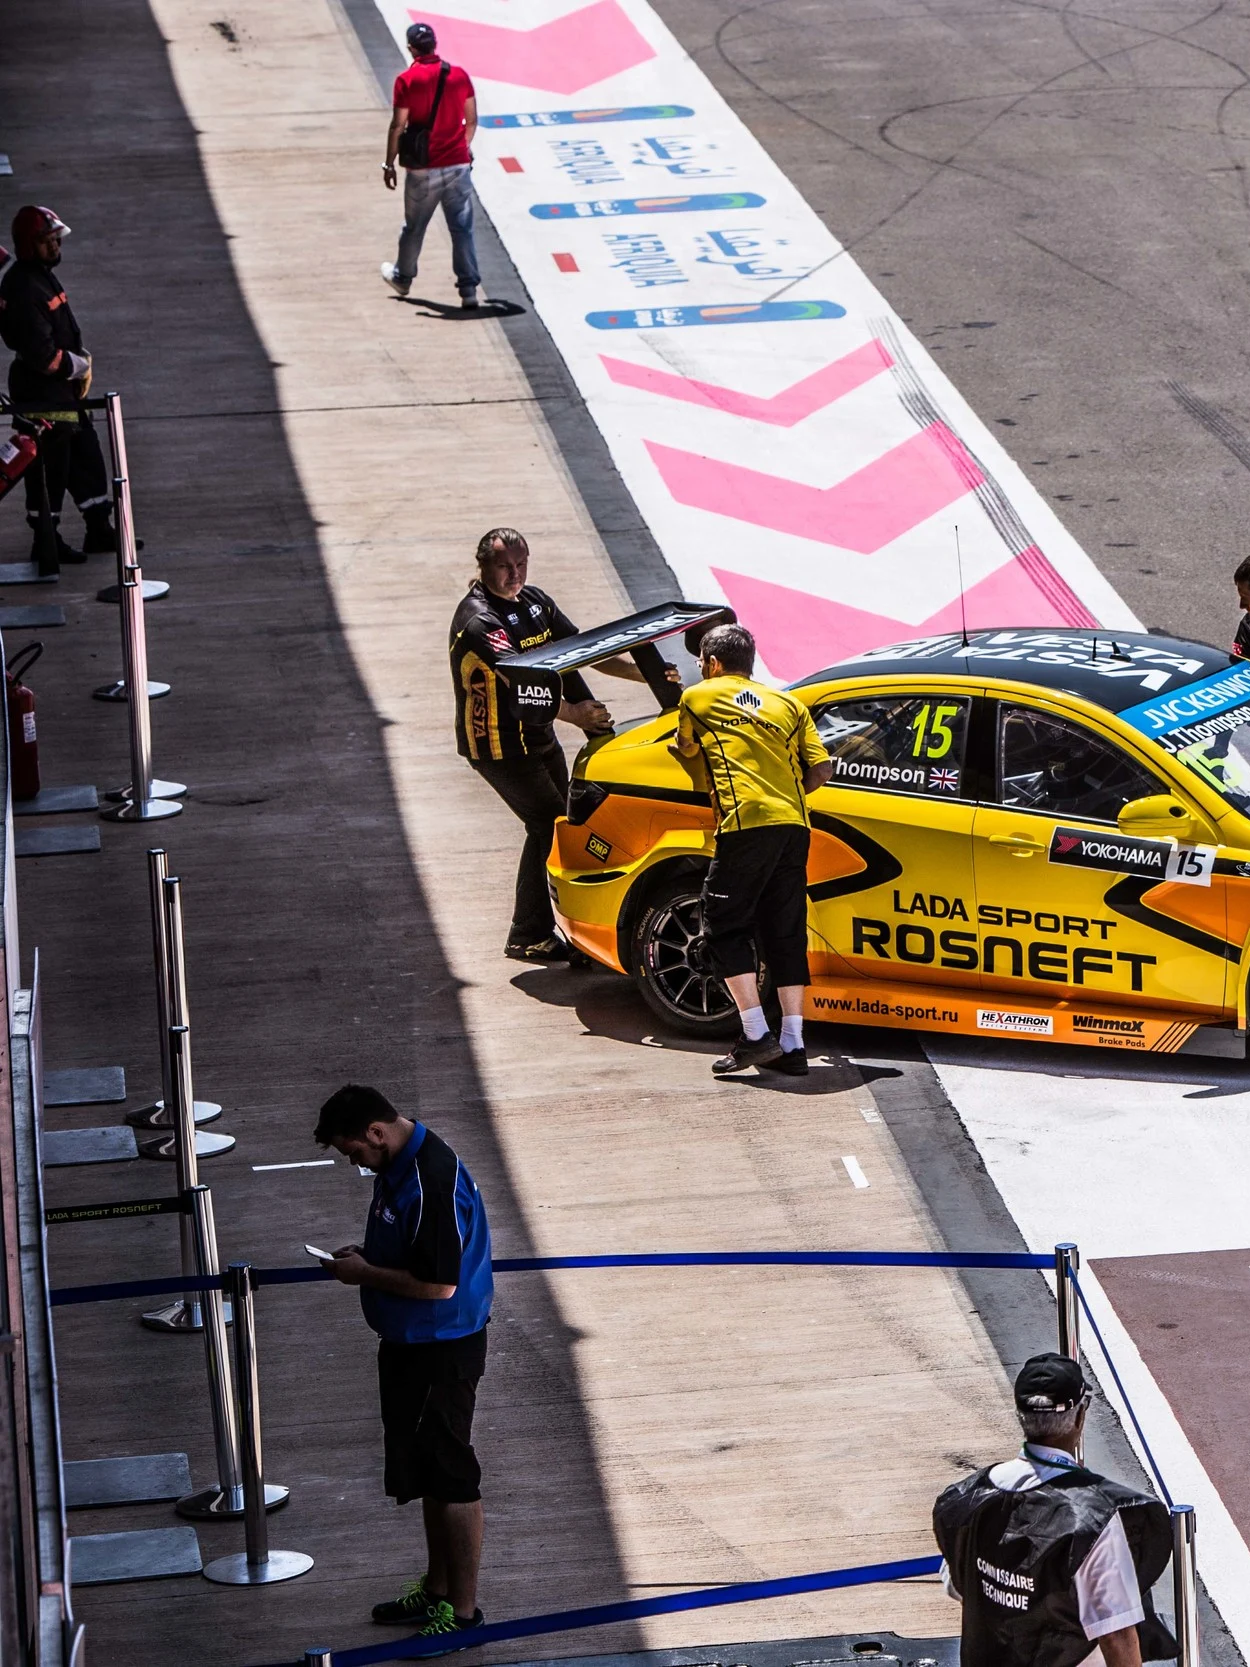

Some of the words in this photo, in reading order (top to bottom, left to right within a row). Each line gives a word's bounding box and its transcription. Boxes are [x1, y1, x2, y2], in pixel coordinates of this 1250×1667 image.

[601, 234, 690, 288] AFRIQUIA
[985, 632, 1206, 675] VESTA
[951, 646, 1173, 692] VESTA
[517, 684, 553, 699] LADA
[517, 698, 553, 707] SPORT
[912, 704, 958, 759] 15
[589, 838, 609, 857] OMP
[1080, 840, 1162, 867] YOKOHAMA
[1176, 850, 1206, 877] 15
[893, 889, 970, 922] LADA
[978, 904, 1117, 940] SPORT
[851, 916, 1157, 992] ROSNEFT
[812, 996, 959, 1023] www.lada-sport.ru
[1098, 1036, 1124, 1047] Brake
[1125, 1038, 1146, 1049] Pads
[47, 1212, 69, 1221] LADA
[71, 1208, 110, 1219] SPORT
[112, 1203, 162, 1215] ROSNEFT
